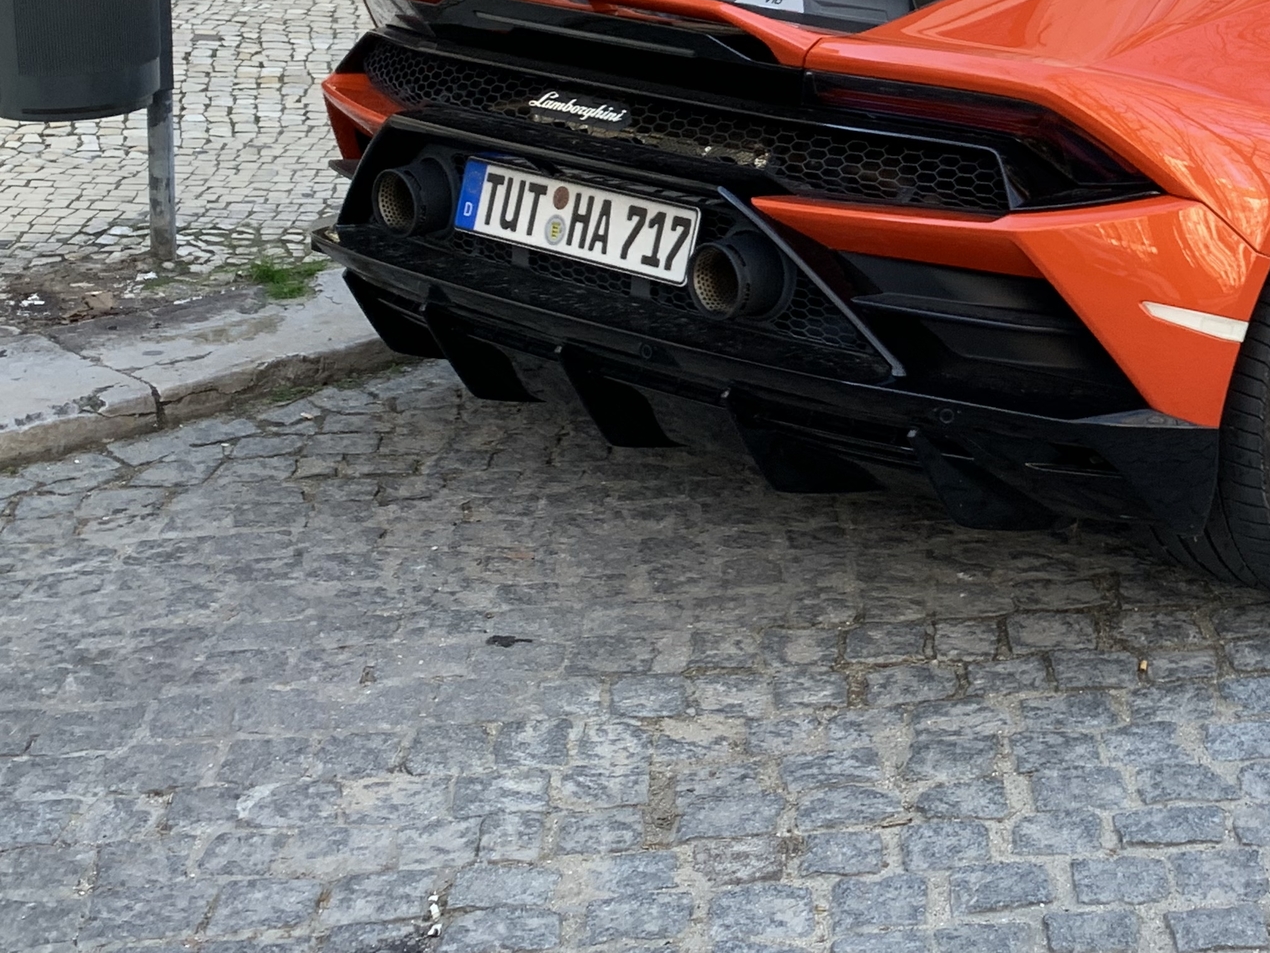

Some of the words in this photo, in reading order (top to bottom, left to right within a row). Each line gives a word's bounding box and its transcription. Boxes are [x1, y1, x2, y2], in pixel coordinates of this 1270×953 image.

[528, 91, 627, 122] Lamborghini
[463, 201, 473, 217] D
[484, 173, 548, 236] TUT
[566, 193, 612, 255] HA
[620, 205, 692, 271] 717
